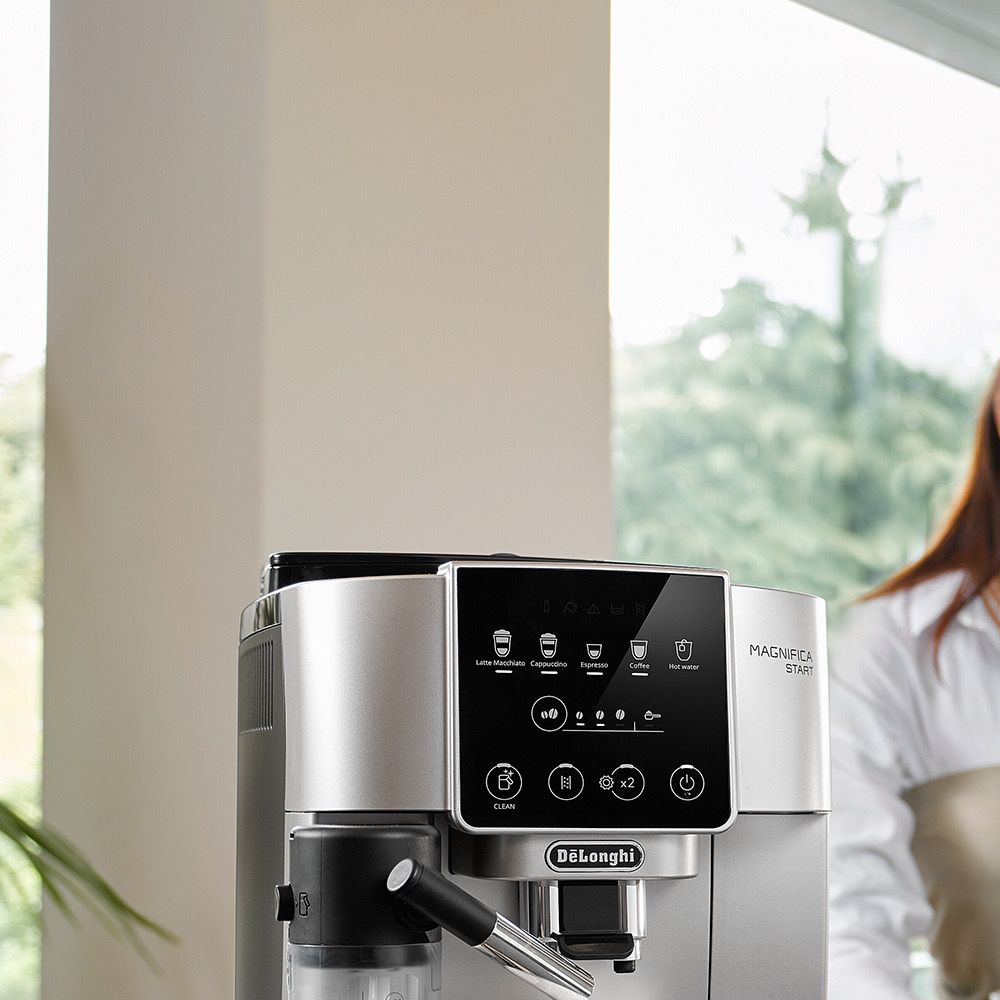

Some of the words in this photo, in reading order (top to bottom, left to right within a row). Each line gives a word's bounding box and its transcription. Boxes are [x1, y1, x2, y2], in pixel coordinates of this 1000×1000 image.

[749, 644, 813, 663] MAGNIFICA
[493, 659, 526, 667] Macchiato
[530, 660, 568, 668] Cappuccino
[580, 661, 609, 669] Espresso
[785, 663, 814, 676] START
[620, 776, 635, 788] x2
